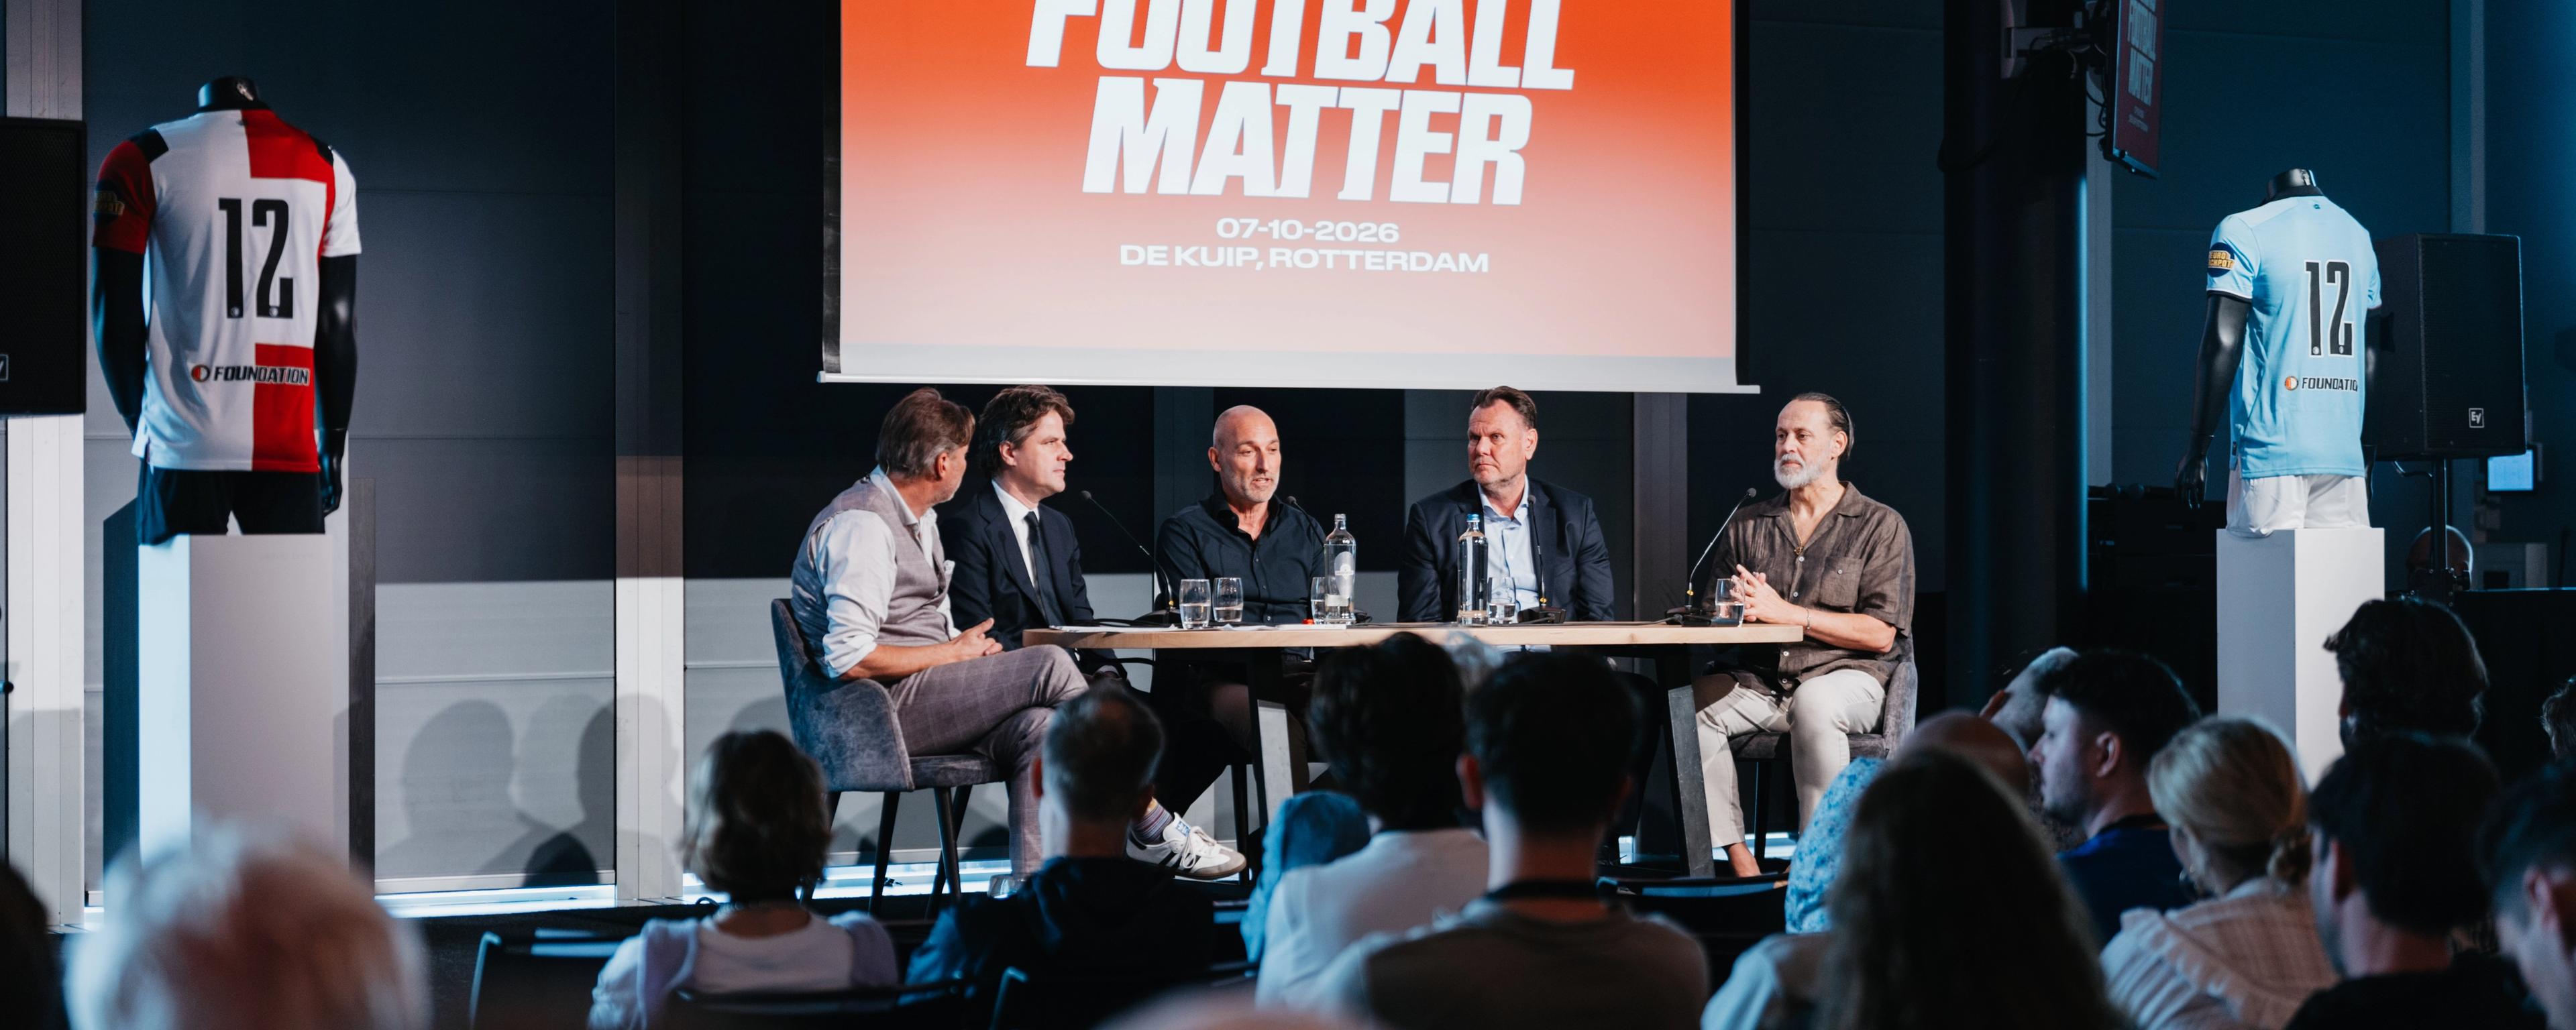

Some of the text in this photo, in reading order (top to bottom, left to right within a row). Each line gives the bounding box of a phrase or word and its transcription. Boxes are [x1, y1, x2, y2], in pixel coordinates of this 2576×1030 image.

[1026, 0, 1575, 90] FOOTBALL
[1082, 76, 1533, 205] MATTER
[219, 198, 293, 319] 12
[1120, 244, 1489, 272] DE KUIP, ROTTERDAM
[1216, 217, 1399, 243] 07-10-2026
[2305, 261, 2353, 356] 12
[214, 365, 309, 385] FOUNDATION
[2302, 377, 2358, 392] FOUNDATIO
